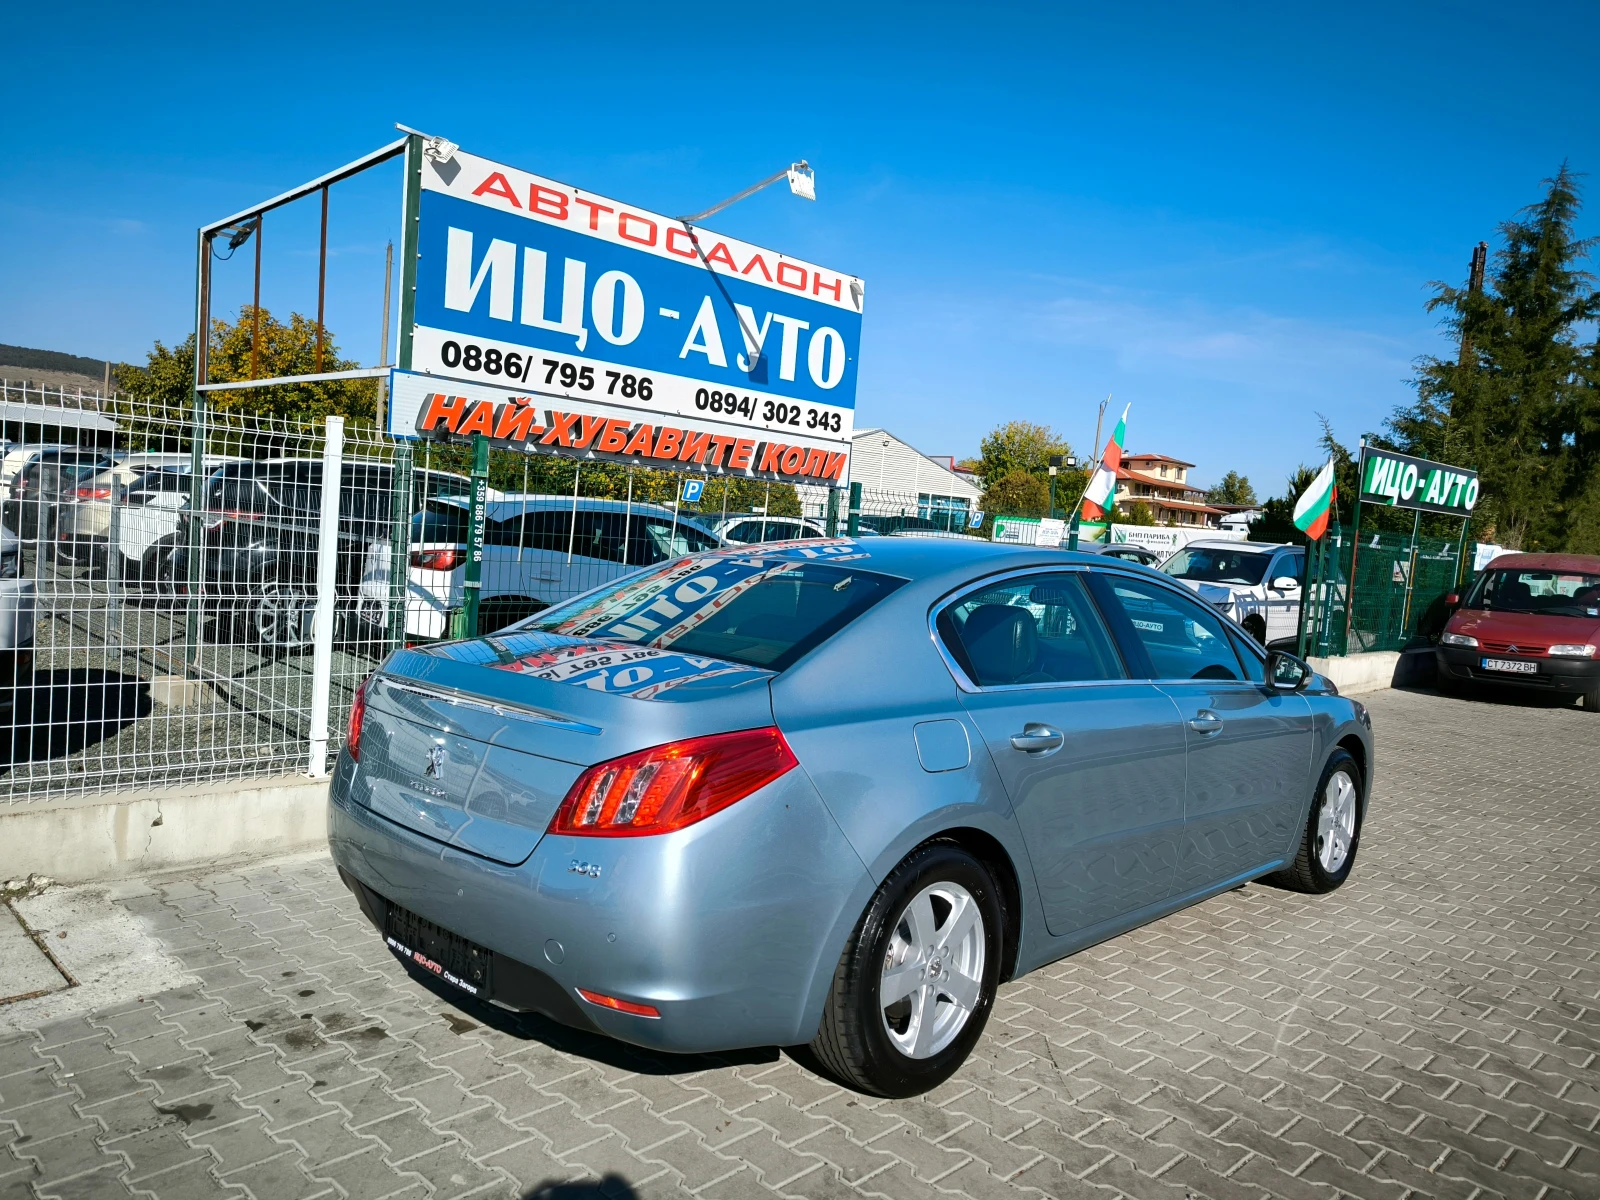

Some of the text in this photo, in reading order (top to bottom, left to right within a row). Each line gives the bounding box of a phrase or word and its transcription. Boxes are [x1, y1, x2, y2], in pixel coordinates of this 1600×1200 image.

[472, 171, 842, 302] АВТОСАЛОН
[441, 340, 842, 433] 0886/ 795 786 0894/ 302 343
[421, 393, 848, 480] НАЙ-ХУБАВИТЕ КОЛИ
[686, 481, 700, 498] P
[1368, 456, 1480, 511] ИЦО-АУТО
[473, 479, 486, 562] +359 886 79 57 86
[1128, 531, 1170, 541] БНП ПАРИБА
[1487, 660, 1536, 672] CT 7372 BH
[567, 858, 602, 879] 508
